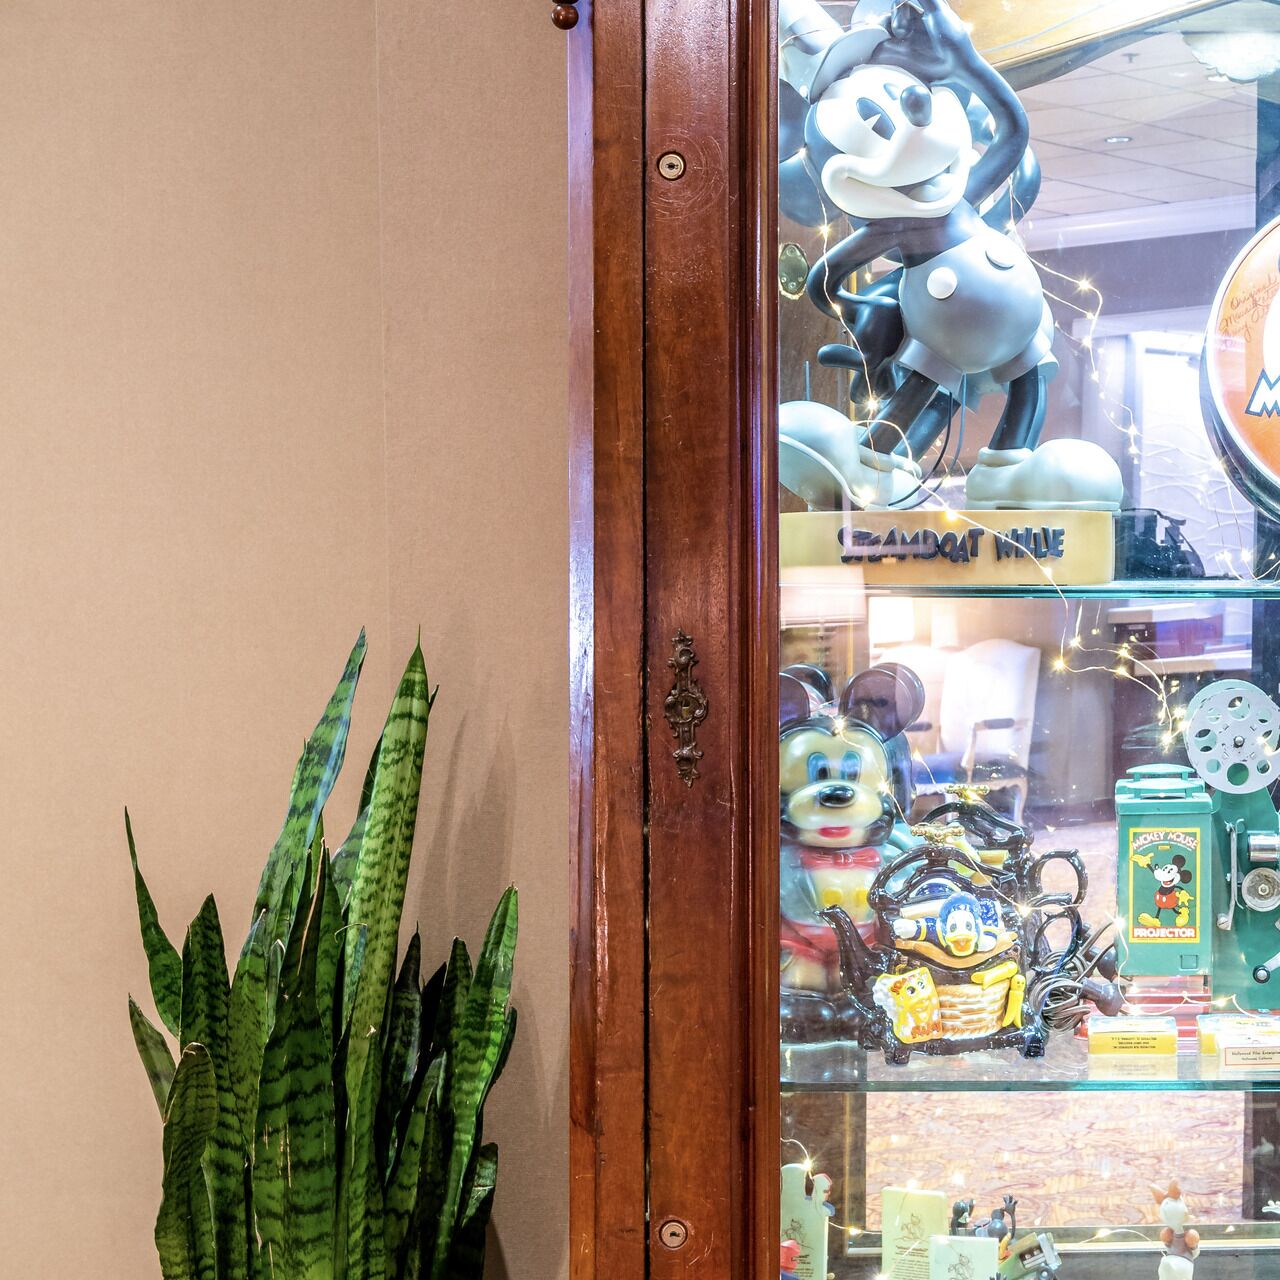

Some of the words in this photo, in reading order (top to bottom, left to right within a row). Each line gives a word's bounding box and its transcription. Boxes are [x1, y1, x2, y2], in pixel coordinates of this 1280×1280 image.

[1132, 831, 1165, 850] MICKEY
[1167, 831, 1198, 850] MOUSE
[1133, 927, 1196, 938] PROJECTOR
